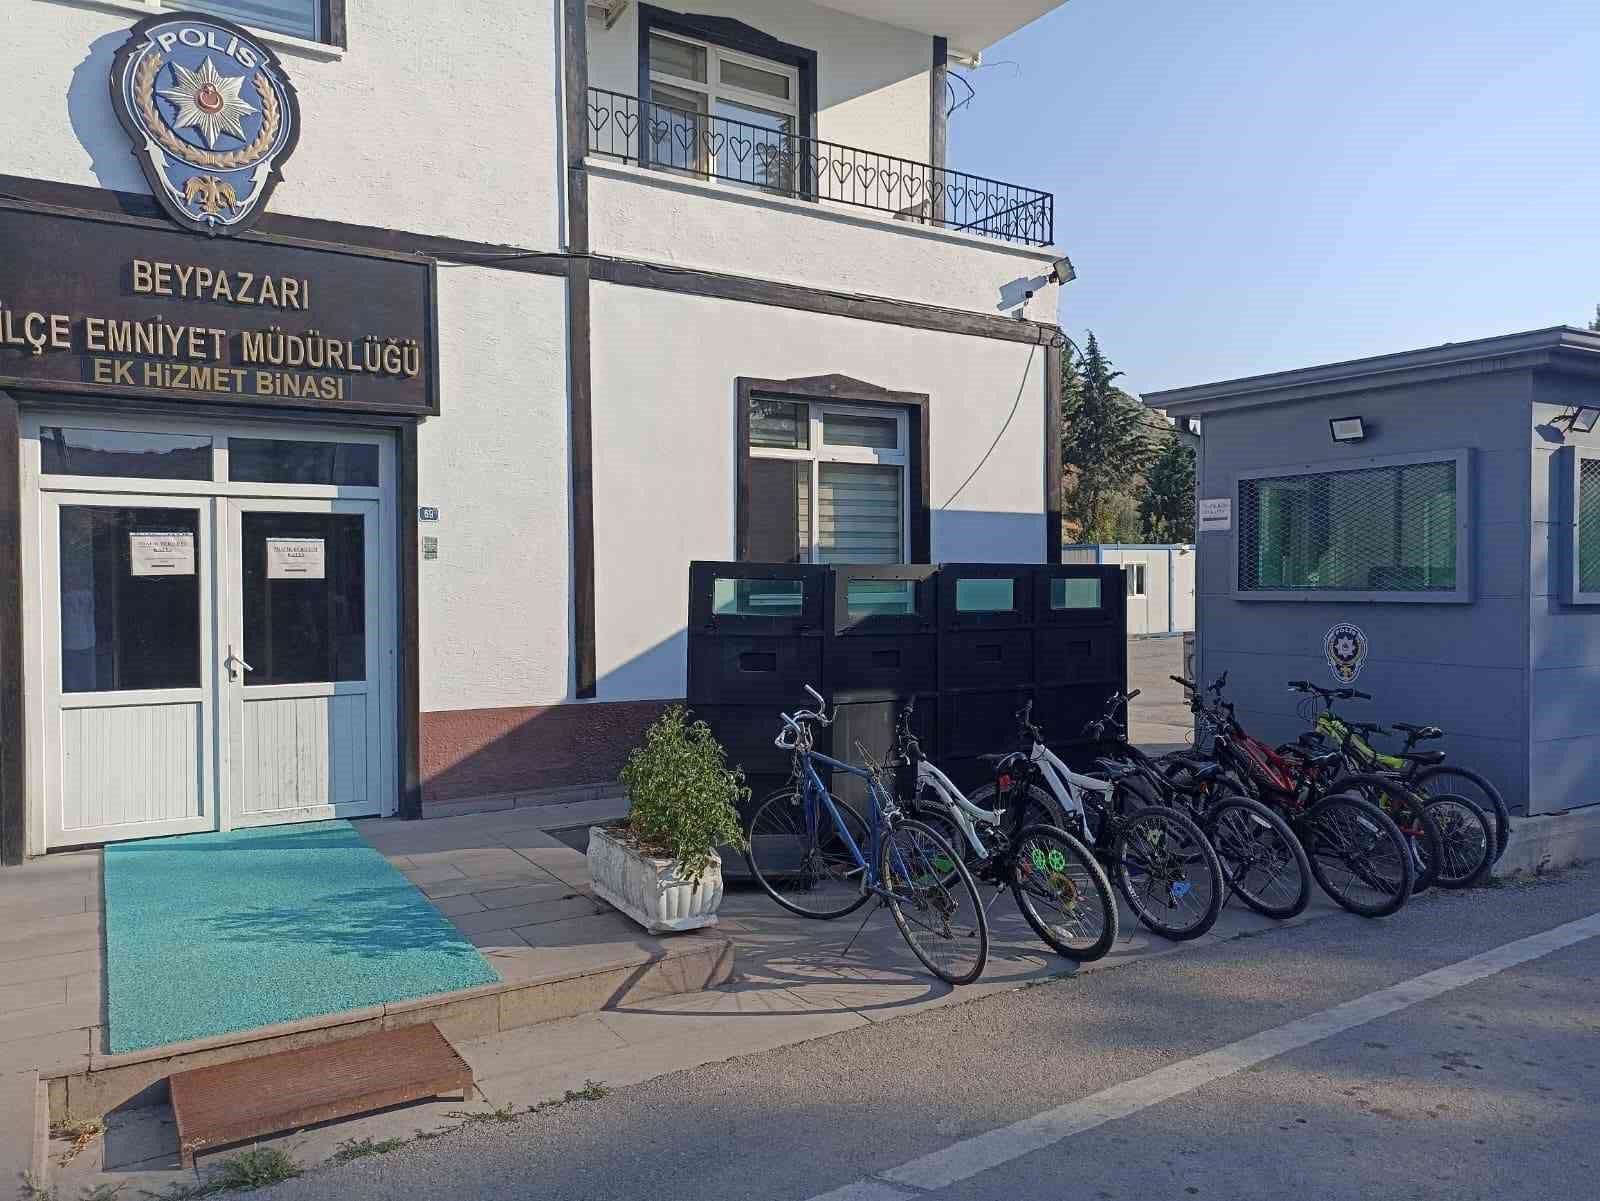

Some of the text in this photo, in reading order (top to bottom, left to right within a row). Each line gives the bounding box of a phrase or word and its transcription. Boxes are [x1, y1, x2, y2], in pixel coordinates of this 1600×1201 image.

[157, 28, 258, 68] POLİS
[132, 258, 310, 312] BEYPAZARI
[86, 314, 226, 361] EMNİYET
[241, 325, 421, 377] MÜDÜRLÜĞÜ
[94, 358, 135, 385] EK
